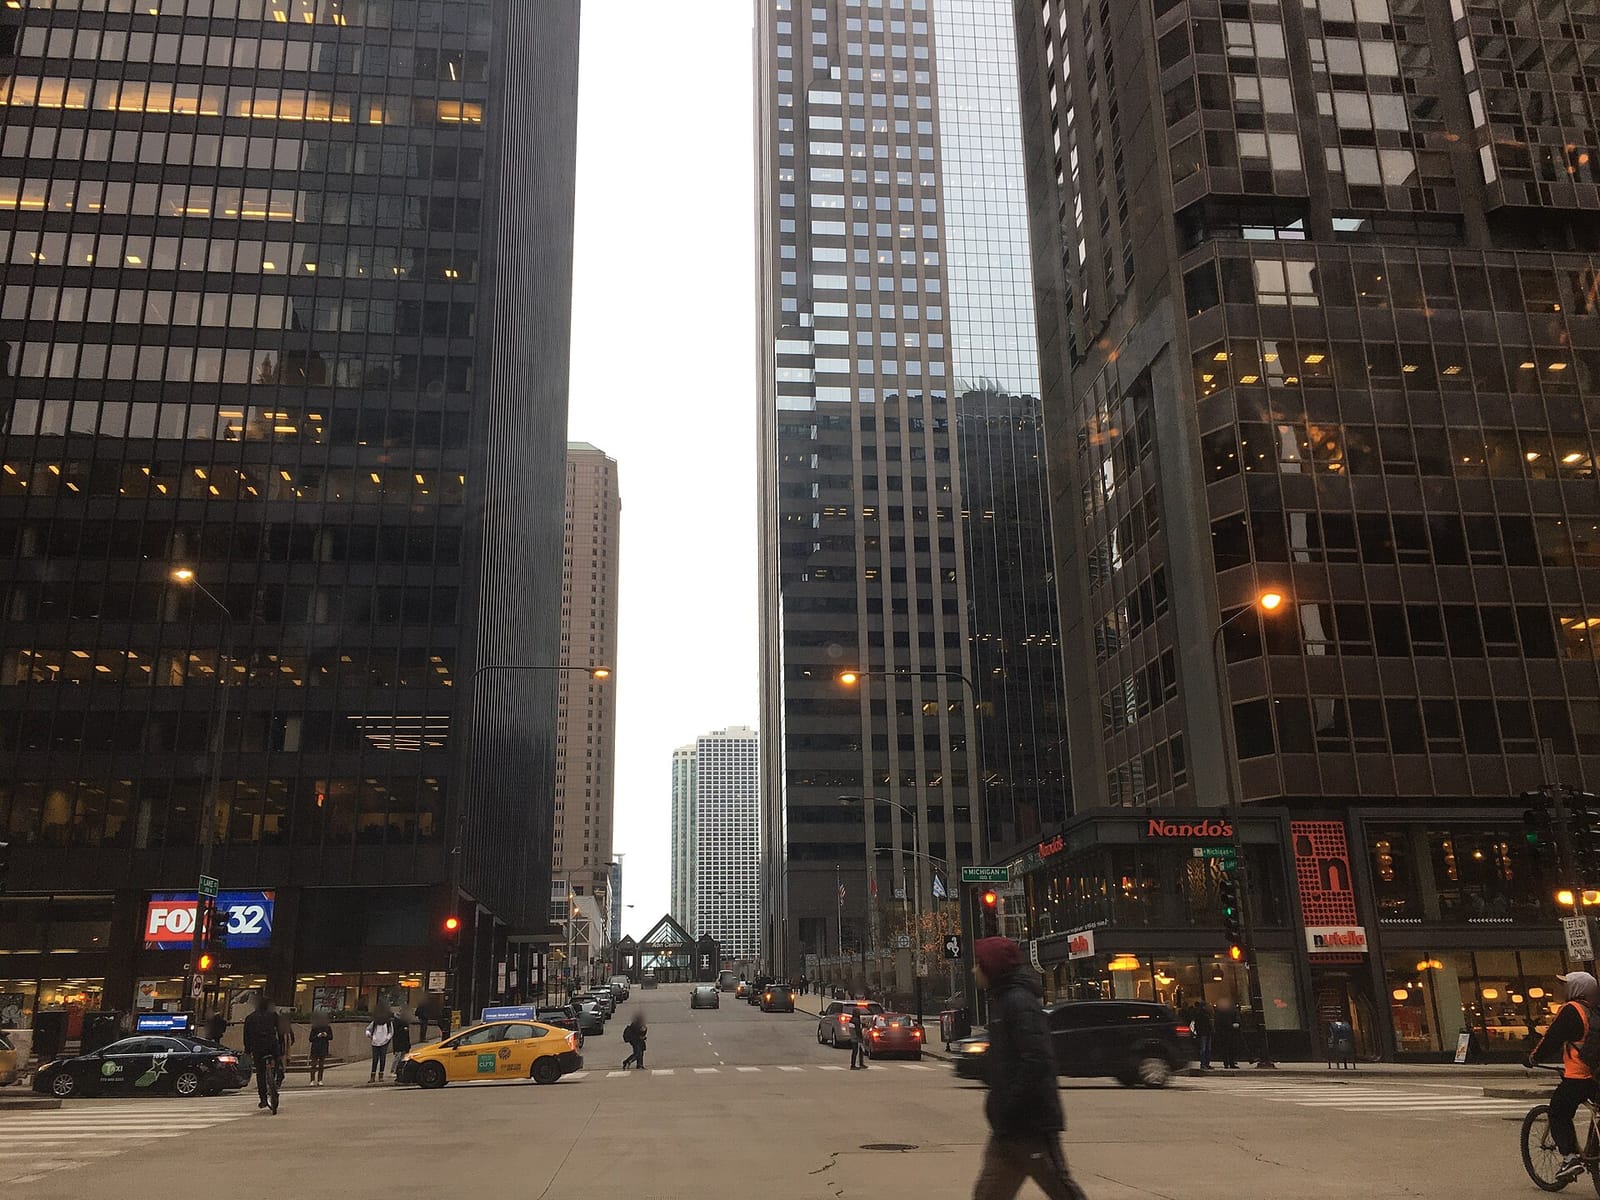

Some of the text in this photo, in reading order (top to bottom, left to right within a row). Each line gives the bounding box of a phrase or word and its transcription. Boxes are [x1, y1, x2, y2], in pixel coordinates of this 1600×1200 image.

[1147, 819, 1233, 837] Nando's
[226, 905, 264, 934] 32
[1565, 920, 1586, 929] LEFT ON
[1568, 929, 1586, 938] GREEN
[1313, 930, 1365, 947] nutella
[1570, 938, 1588, 947] ARROW
[1573, 948, 1586, 957] ONLY
